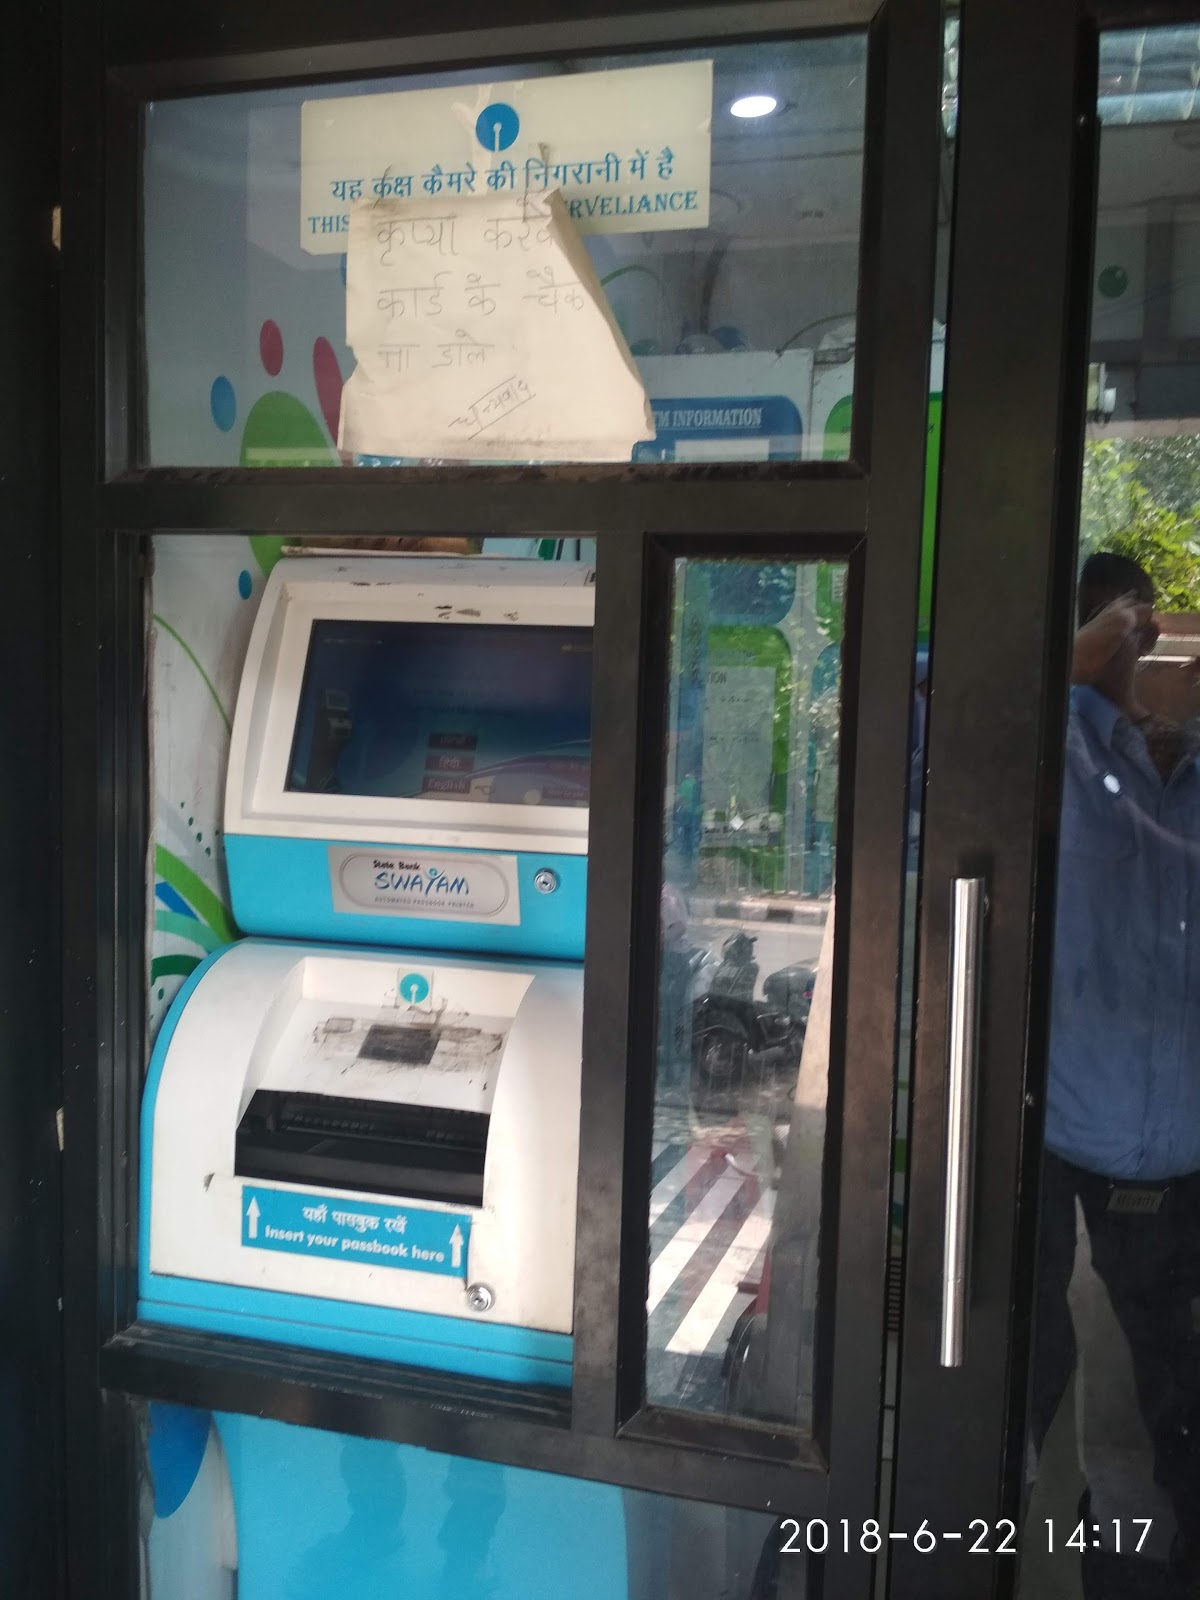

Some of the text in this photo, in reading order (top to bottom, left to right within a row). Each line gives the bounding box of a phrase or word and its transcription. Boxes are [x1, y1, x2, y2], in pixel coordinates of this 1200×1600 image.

[331, 145, 676, 201] यह कक्ष कैमरे की निगरानी में है
[568, 190, 698, 219] RVELIANCE
[308, 214, 350, 234] THIS
[653, 407, 764, 428] TM INFORMATION
[373, 859, 421, 871] State Bank
[374, 867, 470, 897] SWAYAM
[331, 1210, 381, 1234] पासबुक
[265, 1224, 446, 1263] Insert your passbook here
